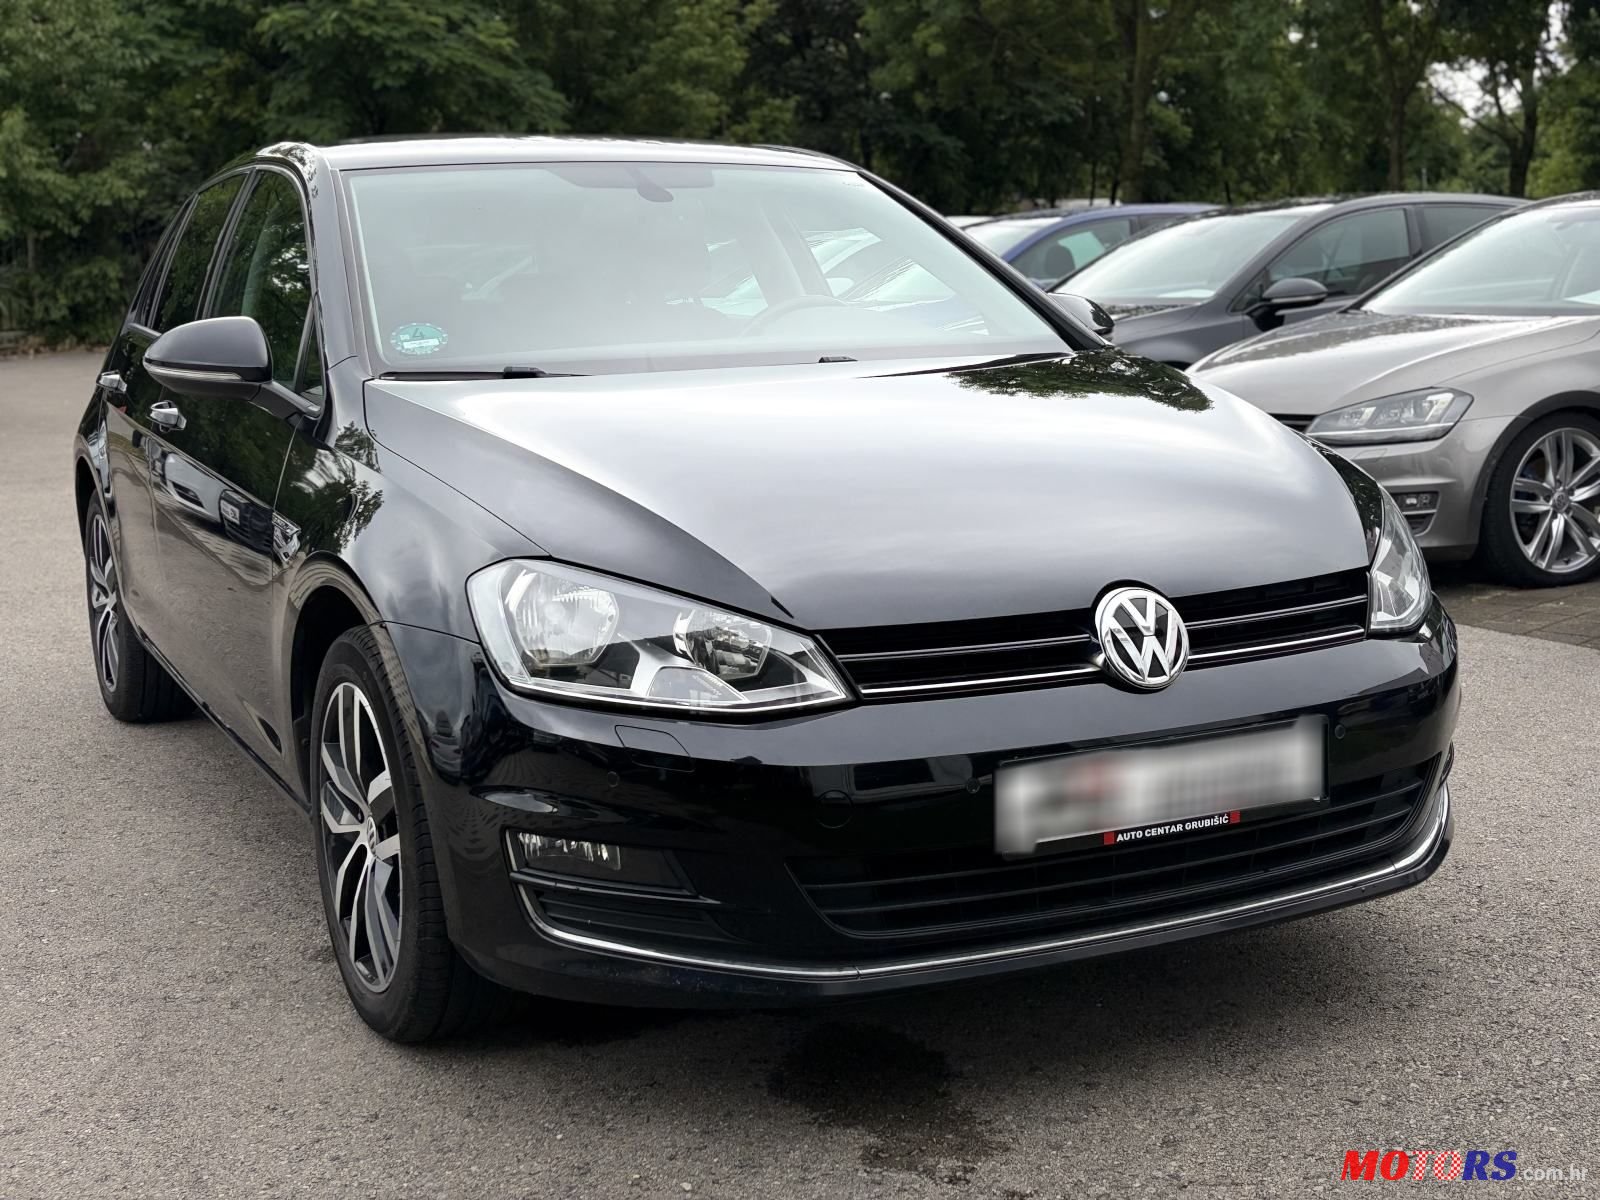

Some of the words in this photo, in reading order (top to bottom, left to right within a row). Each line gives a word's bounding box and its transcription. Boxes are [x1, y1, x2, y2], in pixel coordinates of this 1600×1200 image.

[1101, 591, 1186, 685] VW
[1116, 830, 1143, 842] AUTO
[1144, 823, 1184, 838] CENTAR
[1185, 813, 1230, 830] GRUBIŠIĆ
